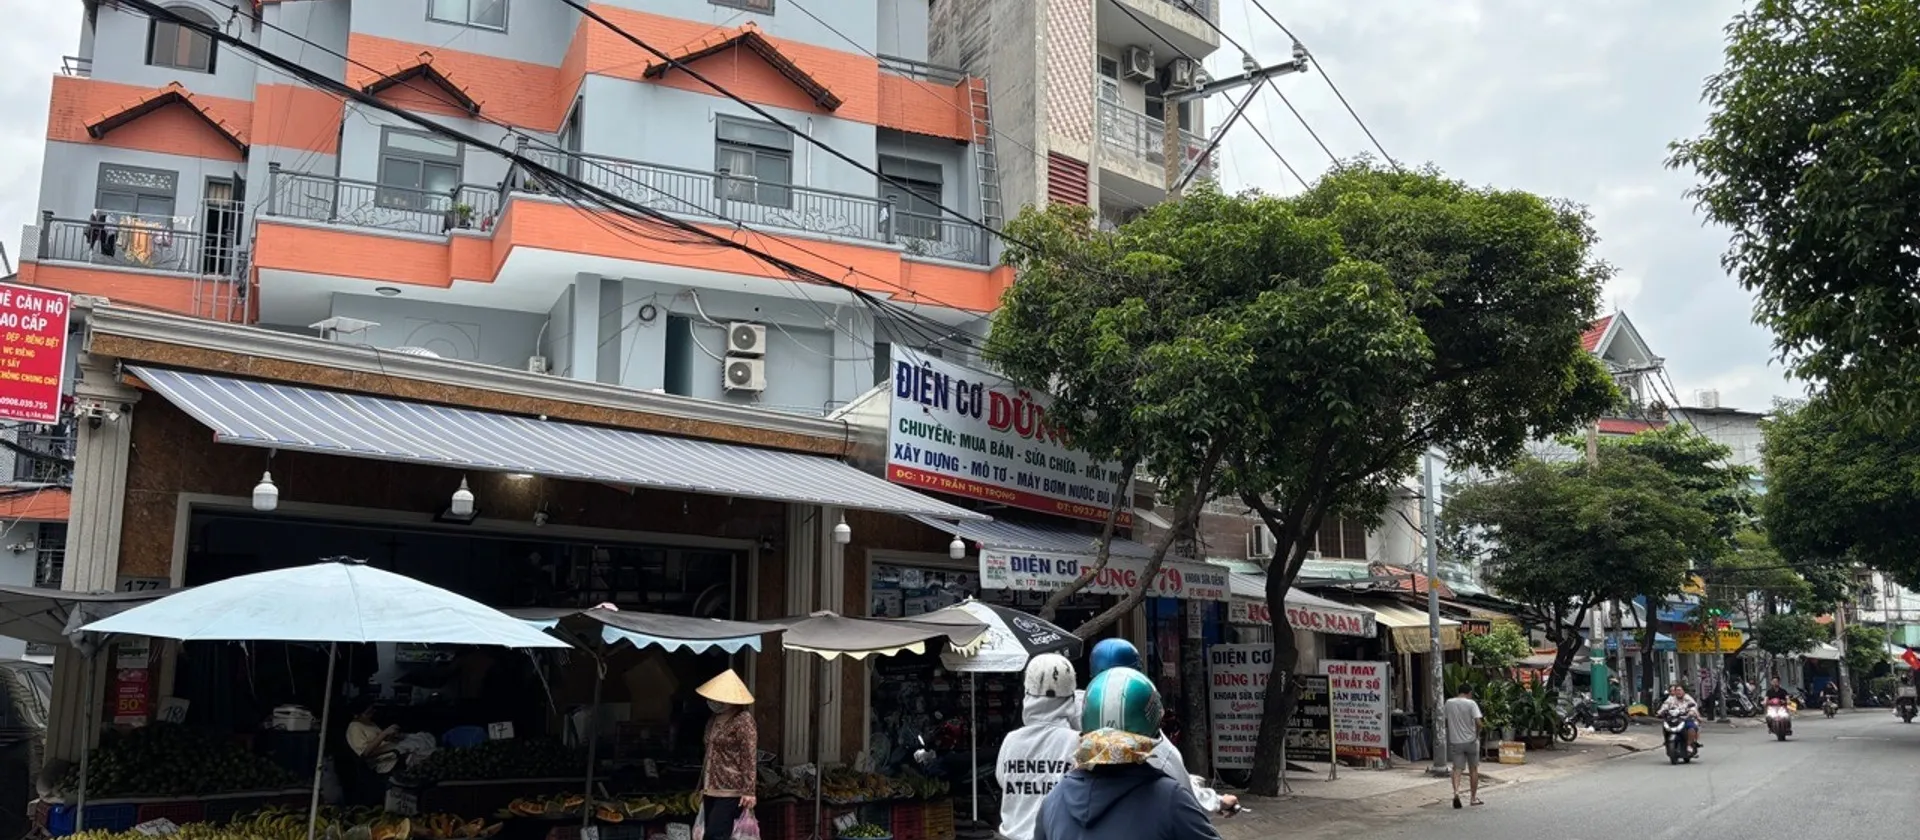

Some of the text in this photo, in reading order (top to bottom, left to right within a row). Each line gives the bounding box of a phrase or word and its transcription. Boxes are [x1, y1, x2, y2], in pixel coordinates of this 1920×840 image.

[16, 293, 43, 312] CĂN
[45, 297, 64, 318] HỘ
[896, 361, 949, 413] ĐIỆN
[956, 379, 983, 419] CƠ
[960, 433, 986, 453] MUA
[990, 440, 1014, 459] BÁN
[1025, 447, 1046, 468] SỬA
[1049, 457, 1077, 475] CHỮA
[894, 443, 920, 463] XÂY
[924, 450, 959, 472] DỤNG
[971, 461, 990, 478] MÔ
[993, 466, 1008, 482] TƠ
[1017, 471, 1041, 490] MÁY
[1043, 477, 1066, 496] BƠM
[1068, 483, 1095, 503] NƯỚC
[896, 469, 916, 481] ĐC:
[919, 474, 938, 486] 177
[940, 477, 966, 492] TRẦN
[968, 484, 983, 496] THỊ
[985, 487, 1016, 501] TRỌNG
[1010, 554, 1051, 577] ĐIỆN
[1056, 560, 1077, 576] CƠ
[124, 580, 160, 592] 177
[1323, 614, 1361, 633] NAM
[1212, 648, 1272, 667] ĐIỆN CƠ
[1328, 663, 1376, 675] CHỈ MAY
[1213, 691, 1237, 700] KHOAN
